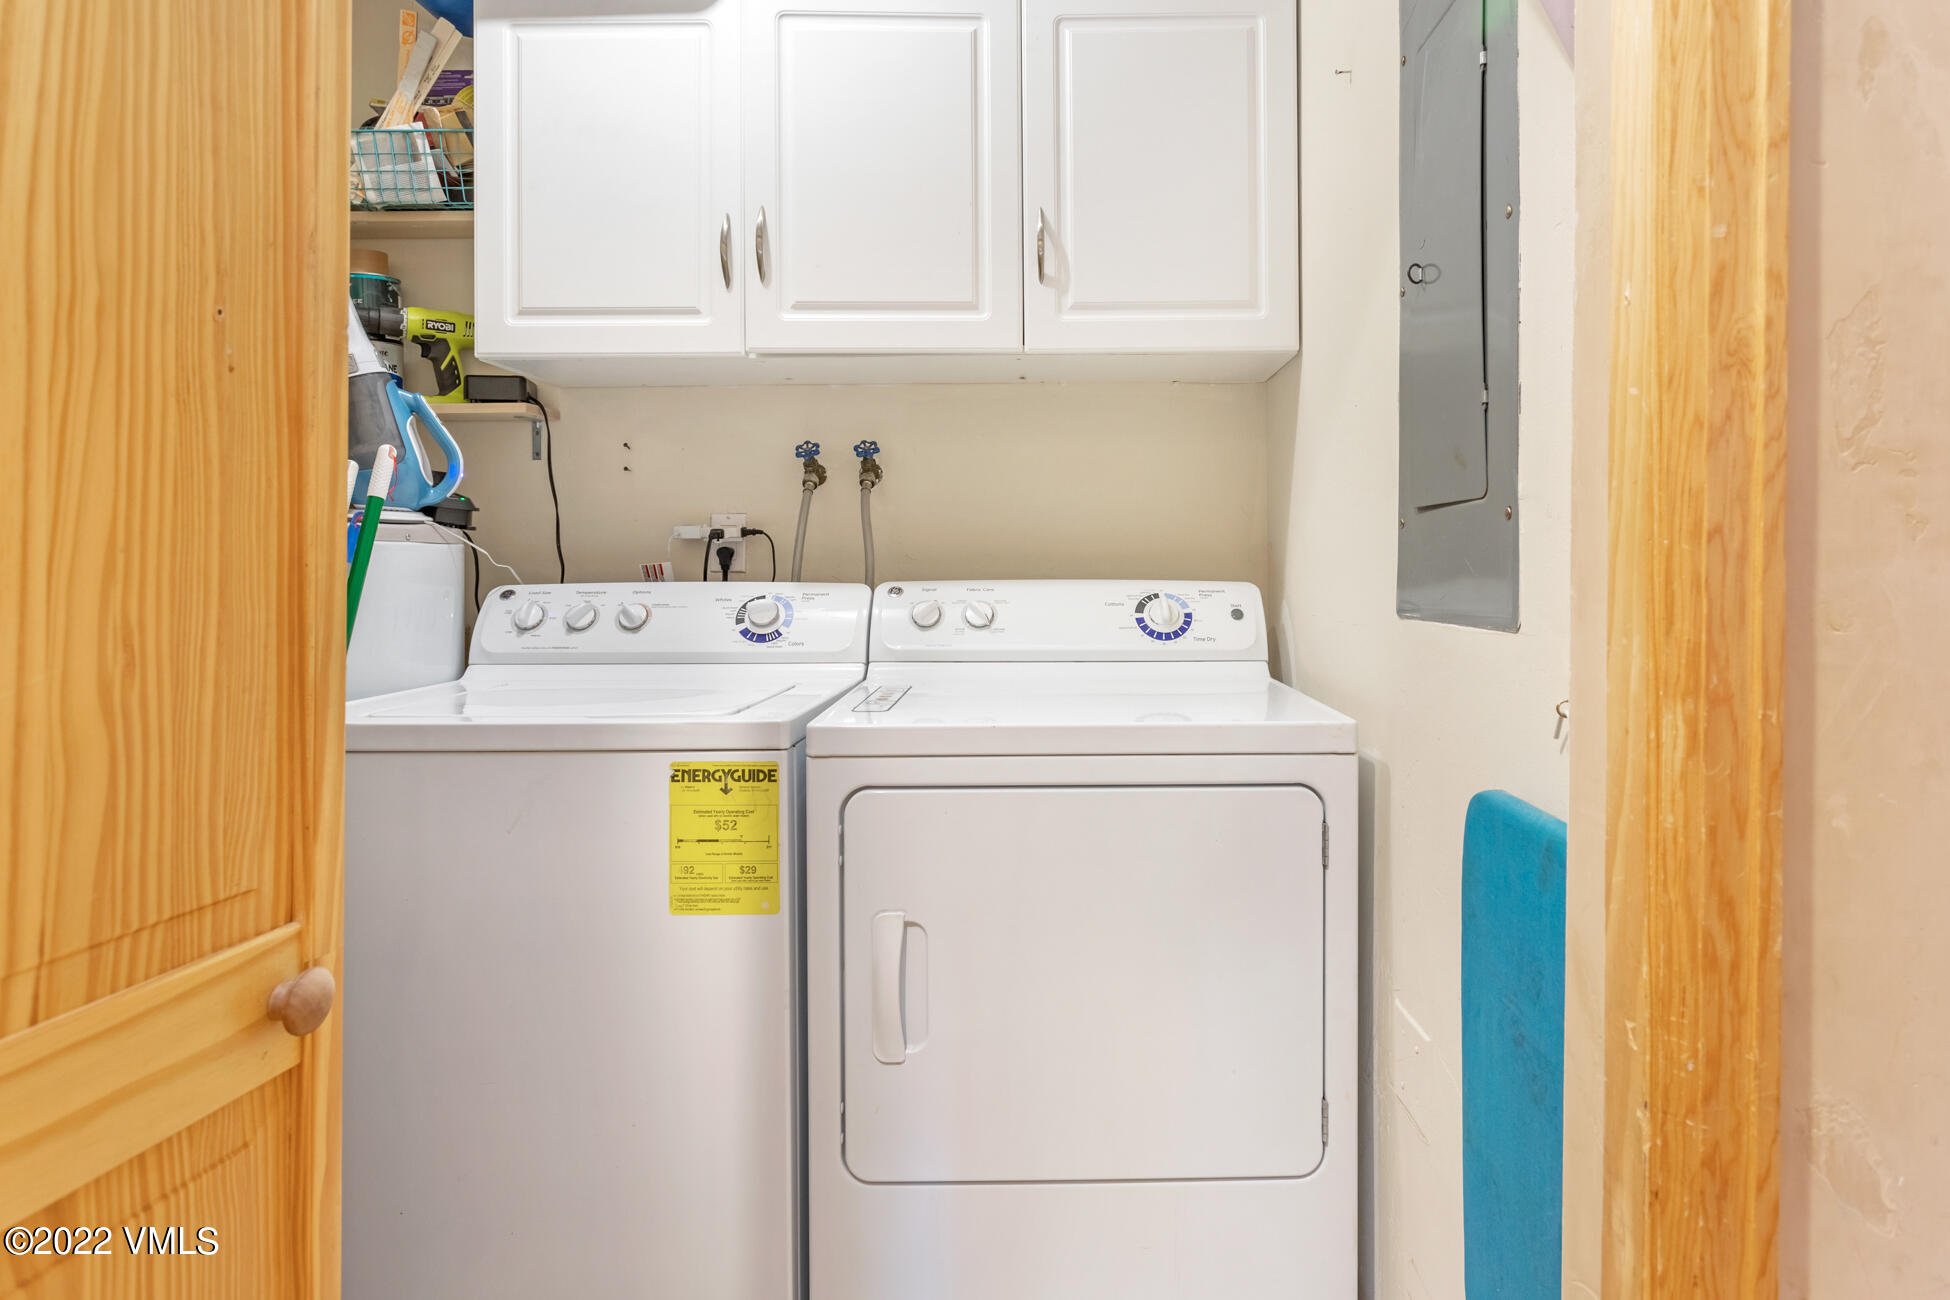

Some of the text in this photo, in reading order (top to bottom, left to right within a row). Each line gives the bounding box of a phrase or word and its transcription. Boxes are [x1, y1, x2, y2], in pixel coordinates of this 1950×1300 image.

[426, 320, 454, 332] RYOBI
[670, 768, 778, 783] ENERGYGUIDE
[714, 819, 738, 832] $52
[739, 865, 757, 875] $29
